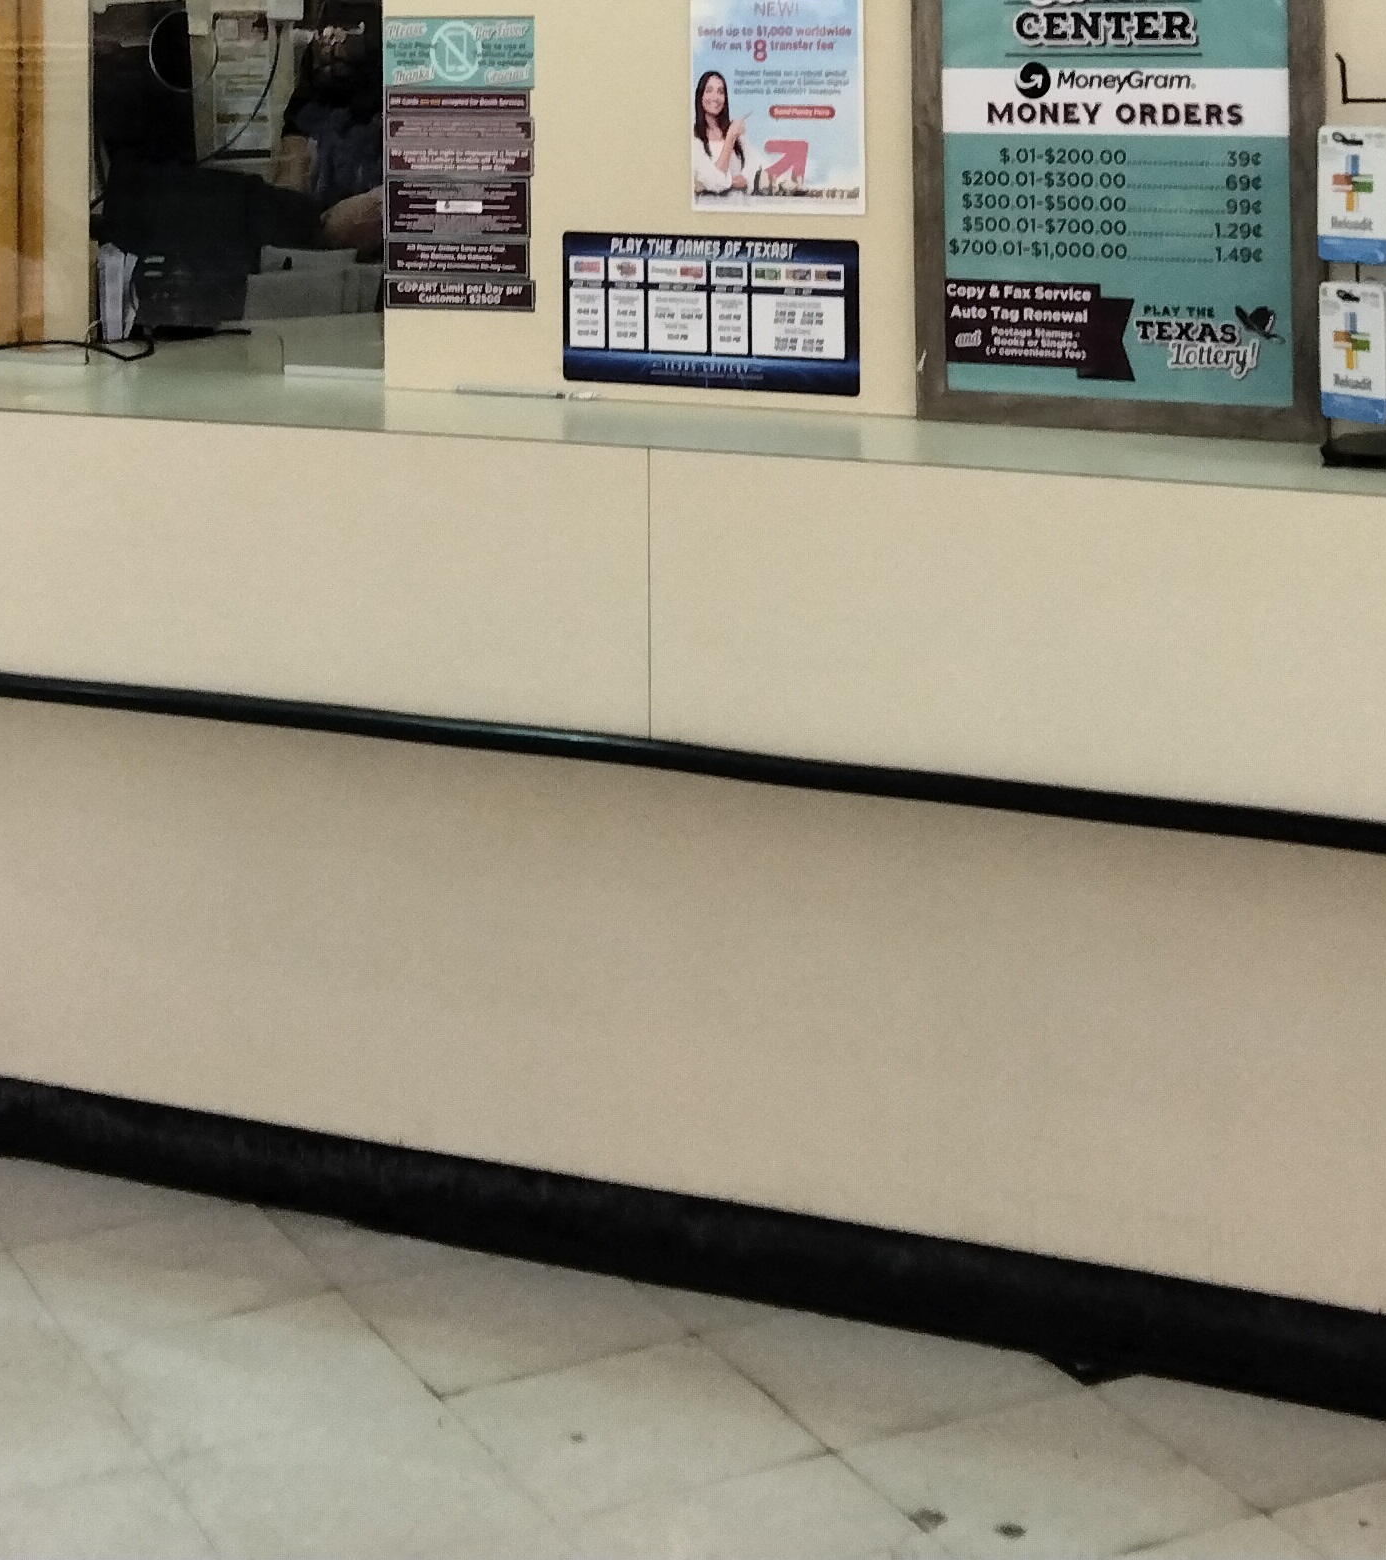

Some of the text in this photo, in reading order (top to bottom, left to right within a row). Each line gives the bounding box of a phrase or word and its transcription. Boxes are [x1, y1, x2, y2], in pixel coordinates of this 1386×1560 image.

[698, 26, 723, 37] Send
[726, 27, 740, 38] up
[741, 26, 753, 37] to
[796, 26, 852, 37] worldwide
[1016, 11, 1196, 43] CENTER
[711, 41, 727, 51] for
[770, 40, 813, 51] transfer
[987, 102, 1243, 126] MONEY ORDERS
[610, 237, 644, 254] PLAY
[647, 238, 671, 255] THE
[724, 241, 742, 256] OF
[947, 284, 1092, 302] Copy & Fax Service
[951, 305, 1088, 323] Auto Tag Renewal
[1144, 306, 1215, 319] PLAY THE
[1135, 320, 1238, 343] TEXAS
[1172, 341, 1259, 377] Lottery!
